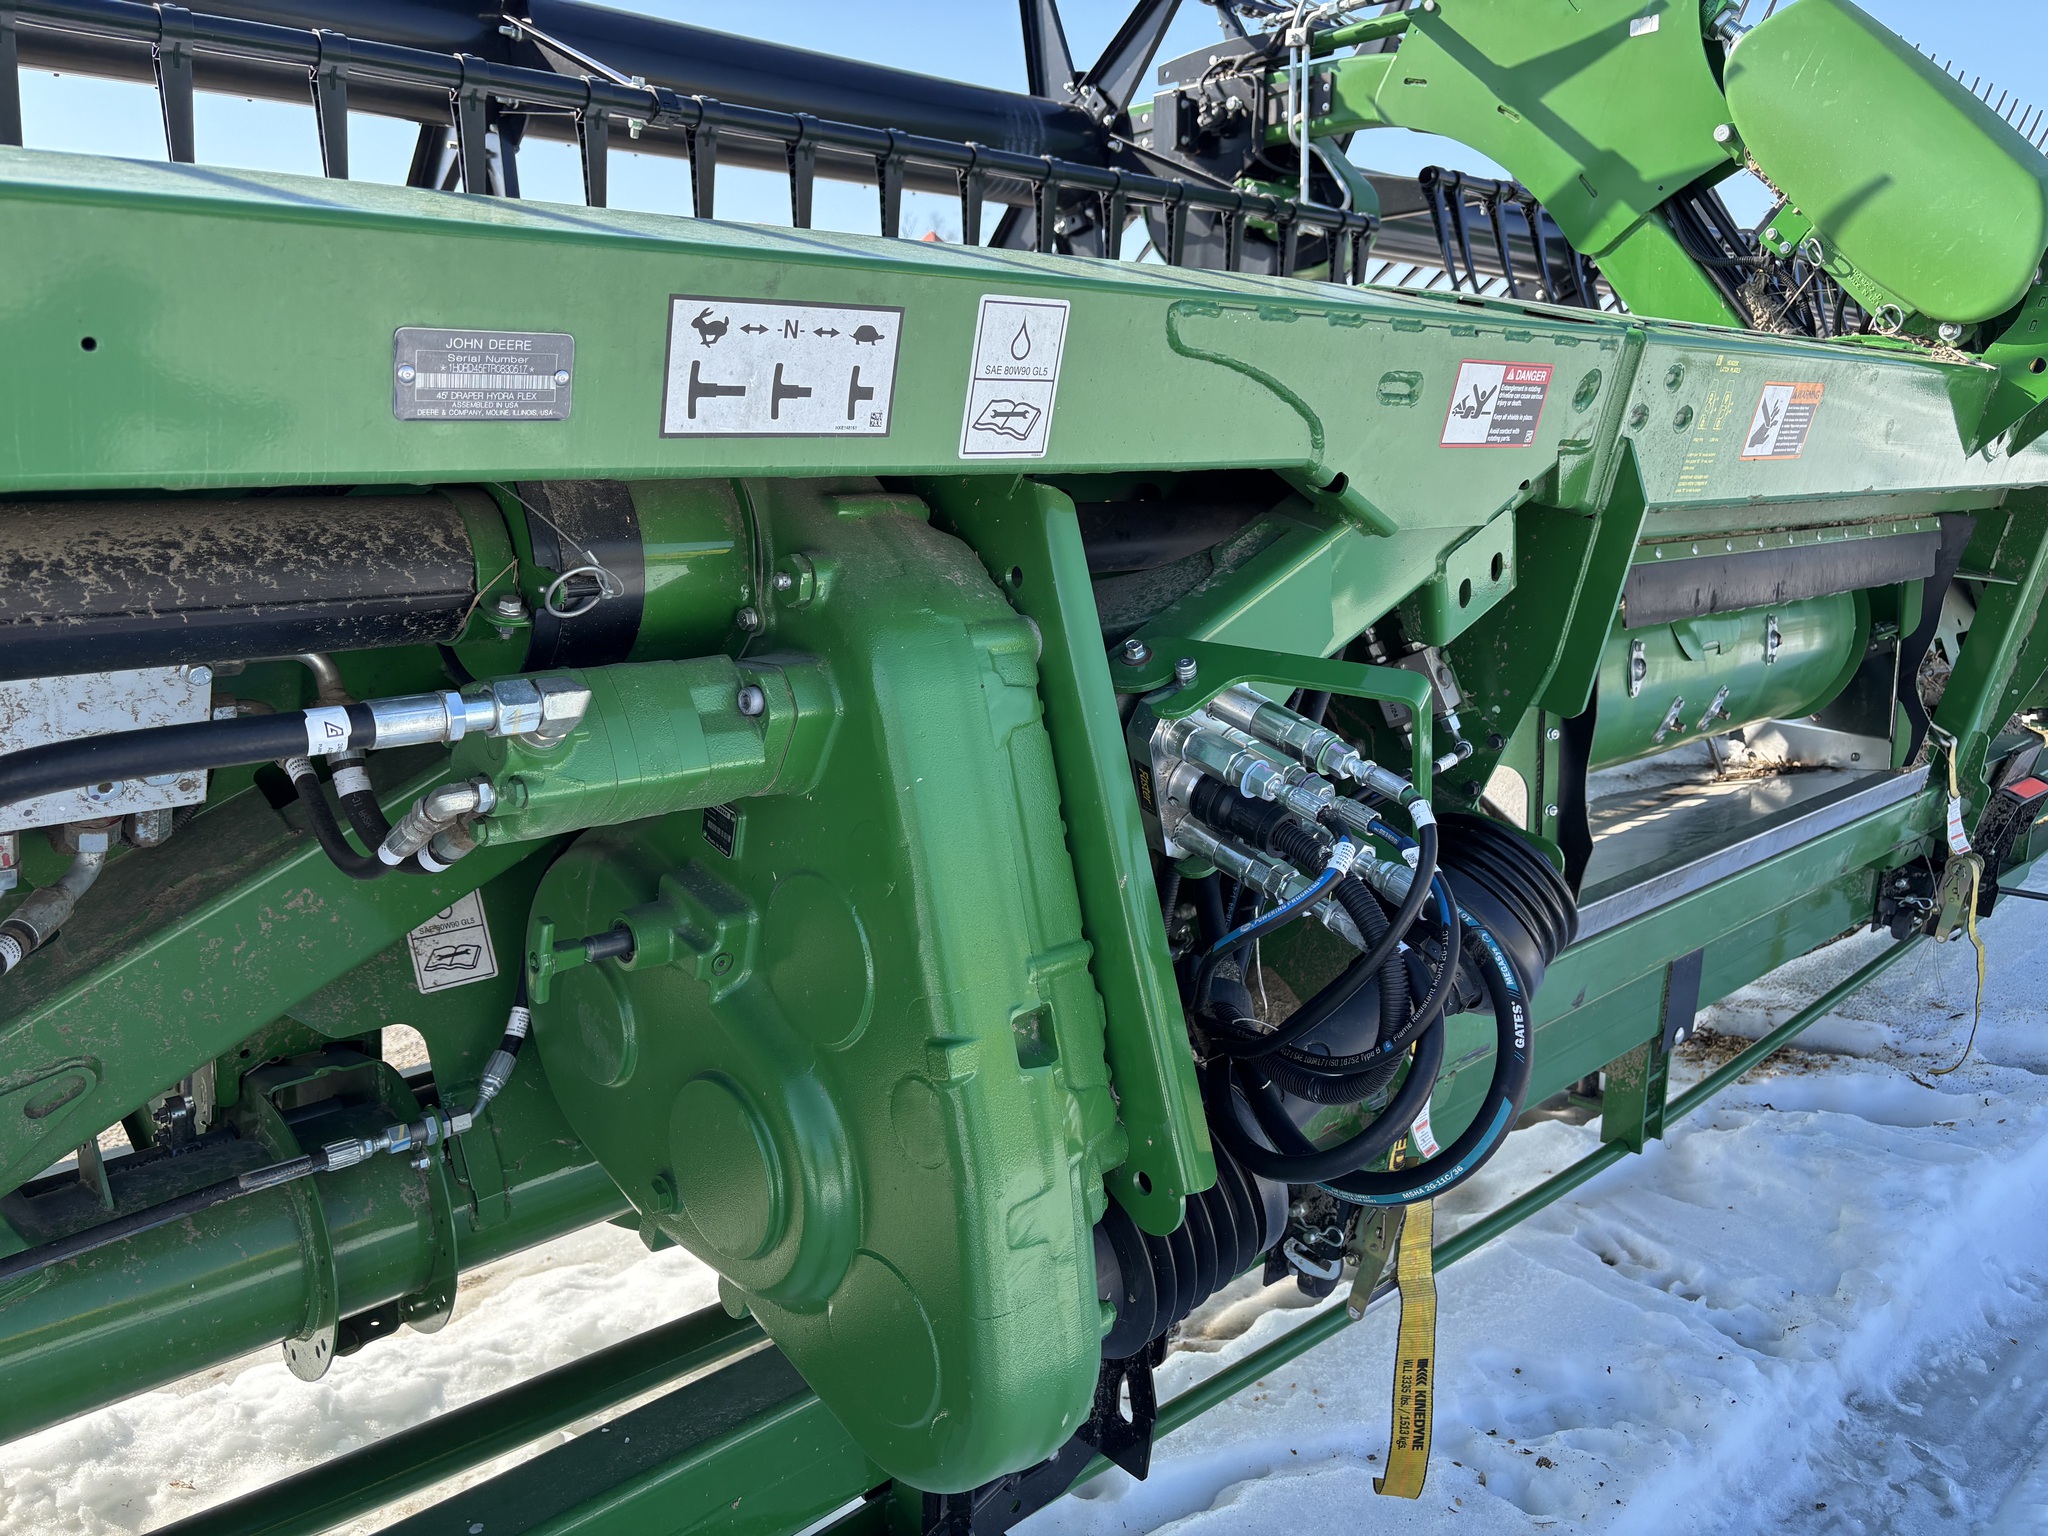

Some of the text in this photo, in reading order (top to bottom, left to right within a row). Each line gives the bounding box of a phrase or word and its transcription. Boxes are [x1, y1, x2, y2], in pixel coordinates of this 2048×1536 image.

[446, 338, 532, 351] JOHN DEERE
[447, 353, 529, 364] Serial Number
[985, 365, 1049, 376] SAE 80W90 GL5
[1515, 370, 1547, 382] DANGER
[451, 391, 484, 400] DRAPER
[486, 392, 514, 400] HYDRA
[517, 392, 538, 400] FLEX
[1254, 902, 1287, 925] POWERING
[419, 925, 435, 935] SAE
[460, 917, 475, 926] GL5
[1393, 1022, 1413, 1042] Flame
[1411, 985, 1437, 1023] Resistant
[1433, 959, 1446, 988] MSHA
[1360, 1051, 1375, 1062] Type
[1402, 1188, 1425, 1199] MSHA
[1402, 1359, 1414, 1374] WLL
[1401, 1375, 1412, 1394] 3335
[1399, 1415, 1411, 1435] 1513
[1411, 1390, 1427, 1451] KINEDYNE
